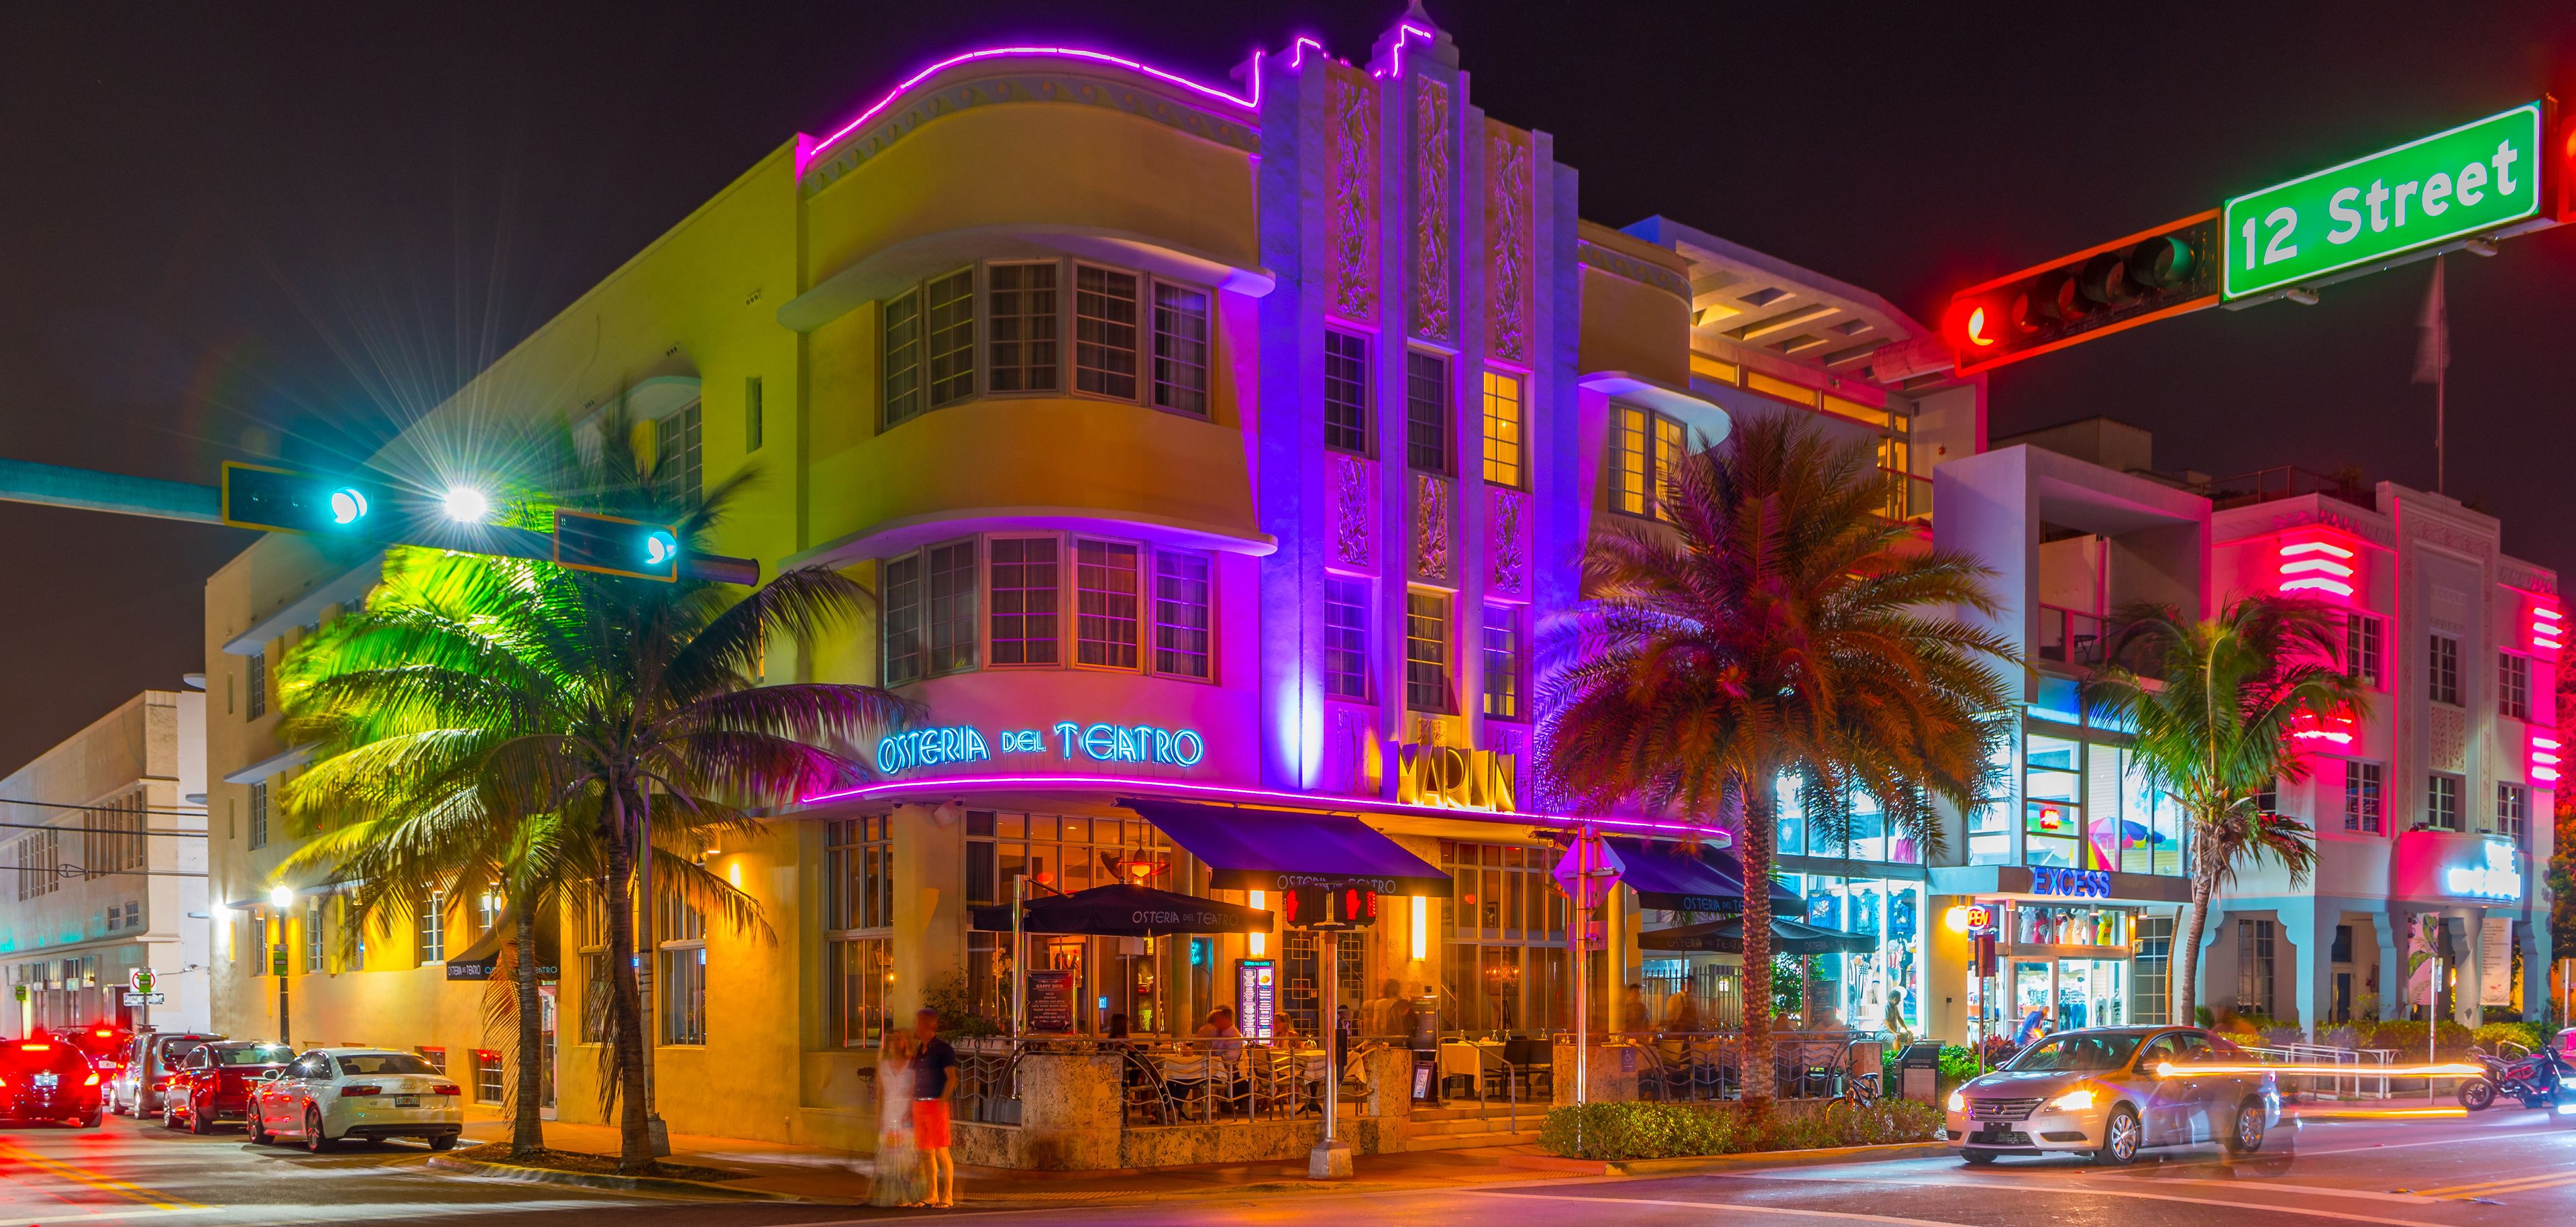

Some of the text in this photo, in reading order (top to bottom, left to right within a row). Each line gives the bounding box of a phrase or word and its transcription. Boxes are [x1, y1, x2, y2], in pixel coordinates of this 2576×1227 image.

[2242, 139, 2518, 270] 12 Street
[877, 721, 1205, 774] OSTERIA DEL TEATRO
[1395, 741, 1516, 812] MARLIN
[2034, 867, 2111, 898] EXCESS
[1684, 897, 1721, 910] OSTERIA
[1132, 911, 1239, 926] OSTERIA DEL TEATRO
[1968, 910, 1989, 926] PEN
[535, 966, 557, 974] EATRO
